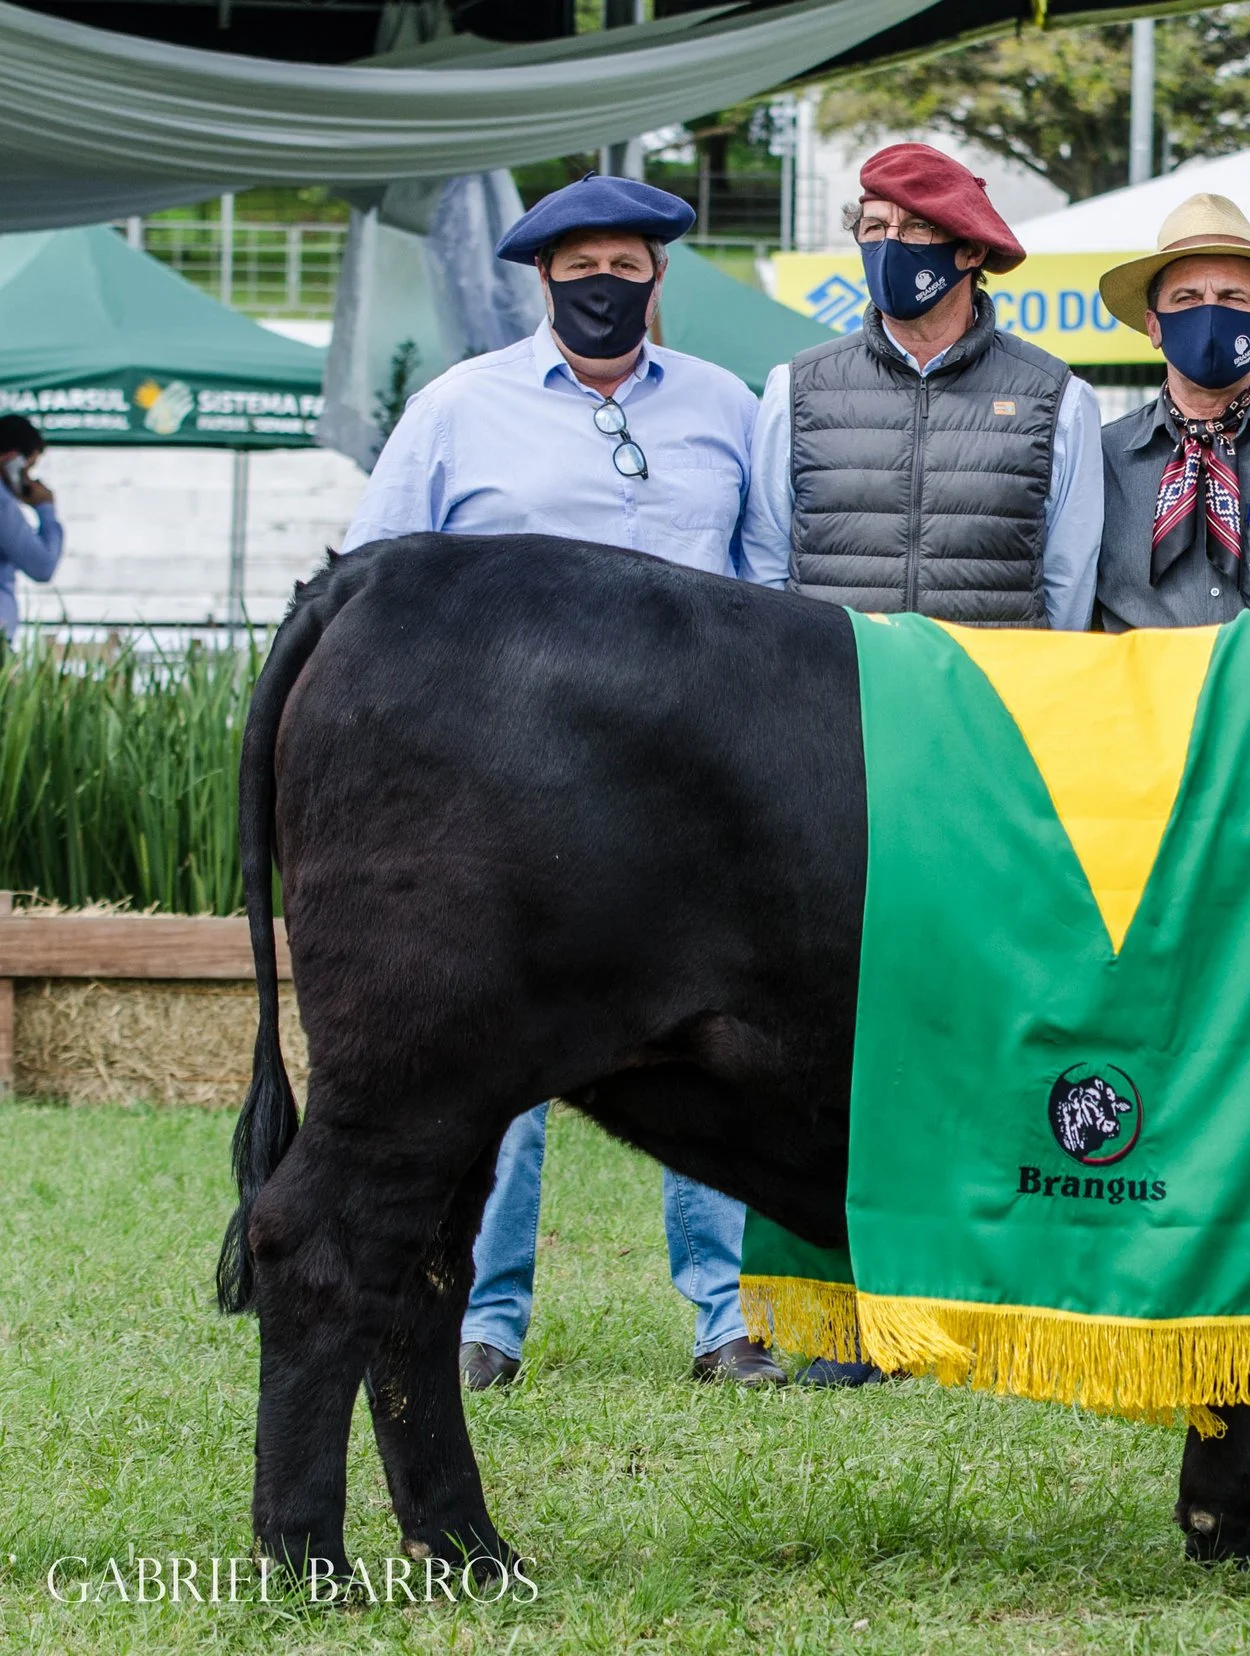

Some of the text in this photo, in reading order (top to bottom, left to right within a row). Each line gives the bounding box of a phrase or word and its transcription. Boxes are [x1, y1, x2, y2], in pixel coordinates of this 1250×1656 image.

[915, 276, 946, 302] BRANGUS
[38, 388, 131, 412] FARSUL
[197, 390, 299, 416] SISTEMA
[1017, 1166, 1167, 1205] Brangus
